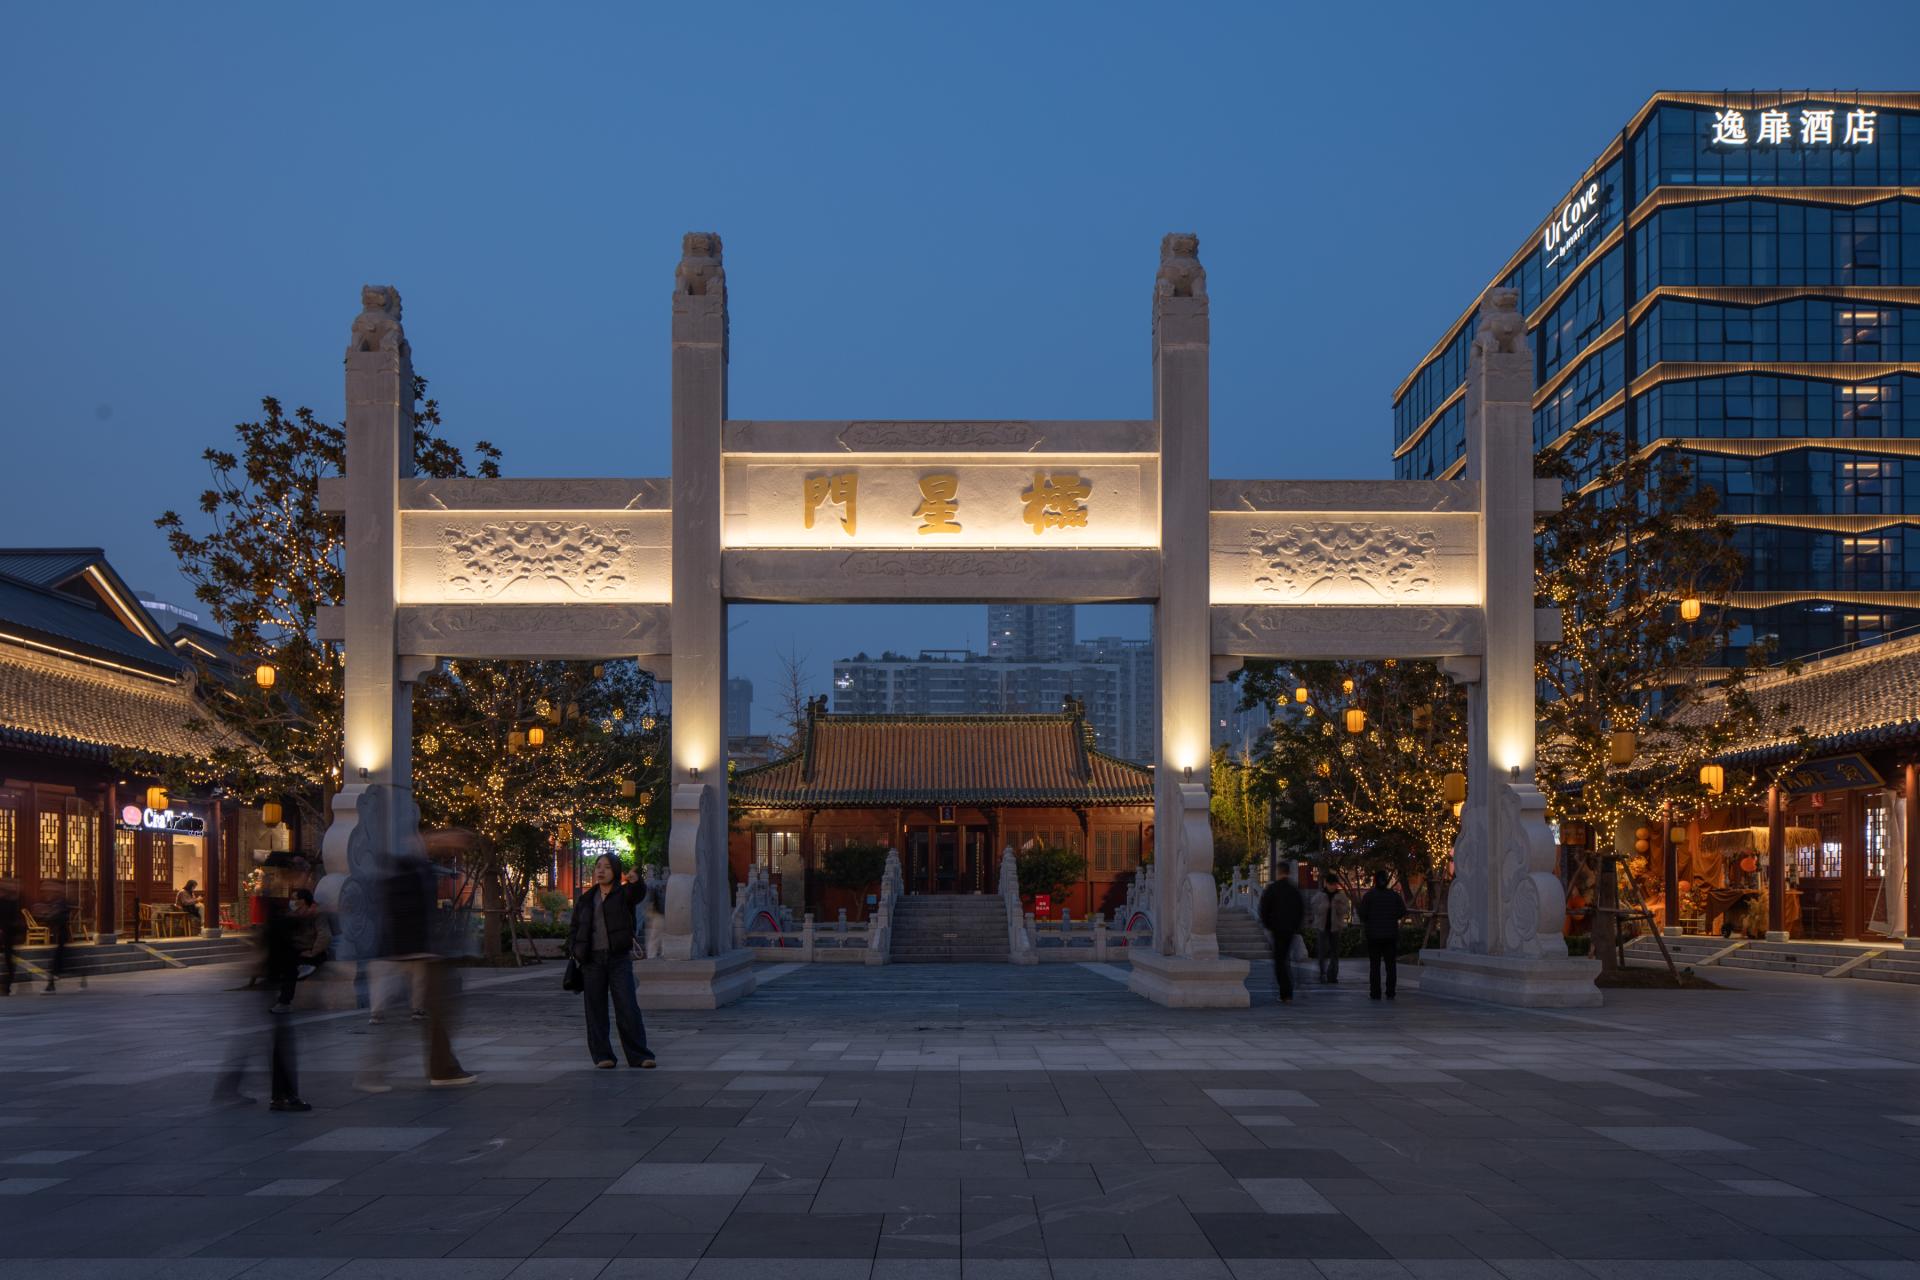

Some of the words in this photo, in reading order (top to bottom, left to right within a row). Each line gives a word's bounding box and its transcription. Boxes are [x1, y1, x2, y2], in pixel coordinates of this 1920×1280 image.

[1711, 108, 1878, 145] 逸扉酒店
[1545, 183, 1598, 251] UrCove
